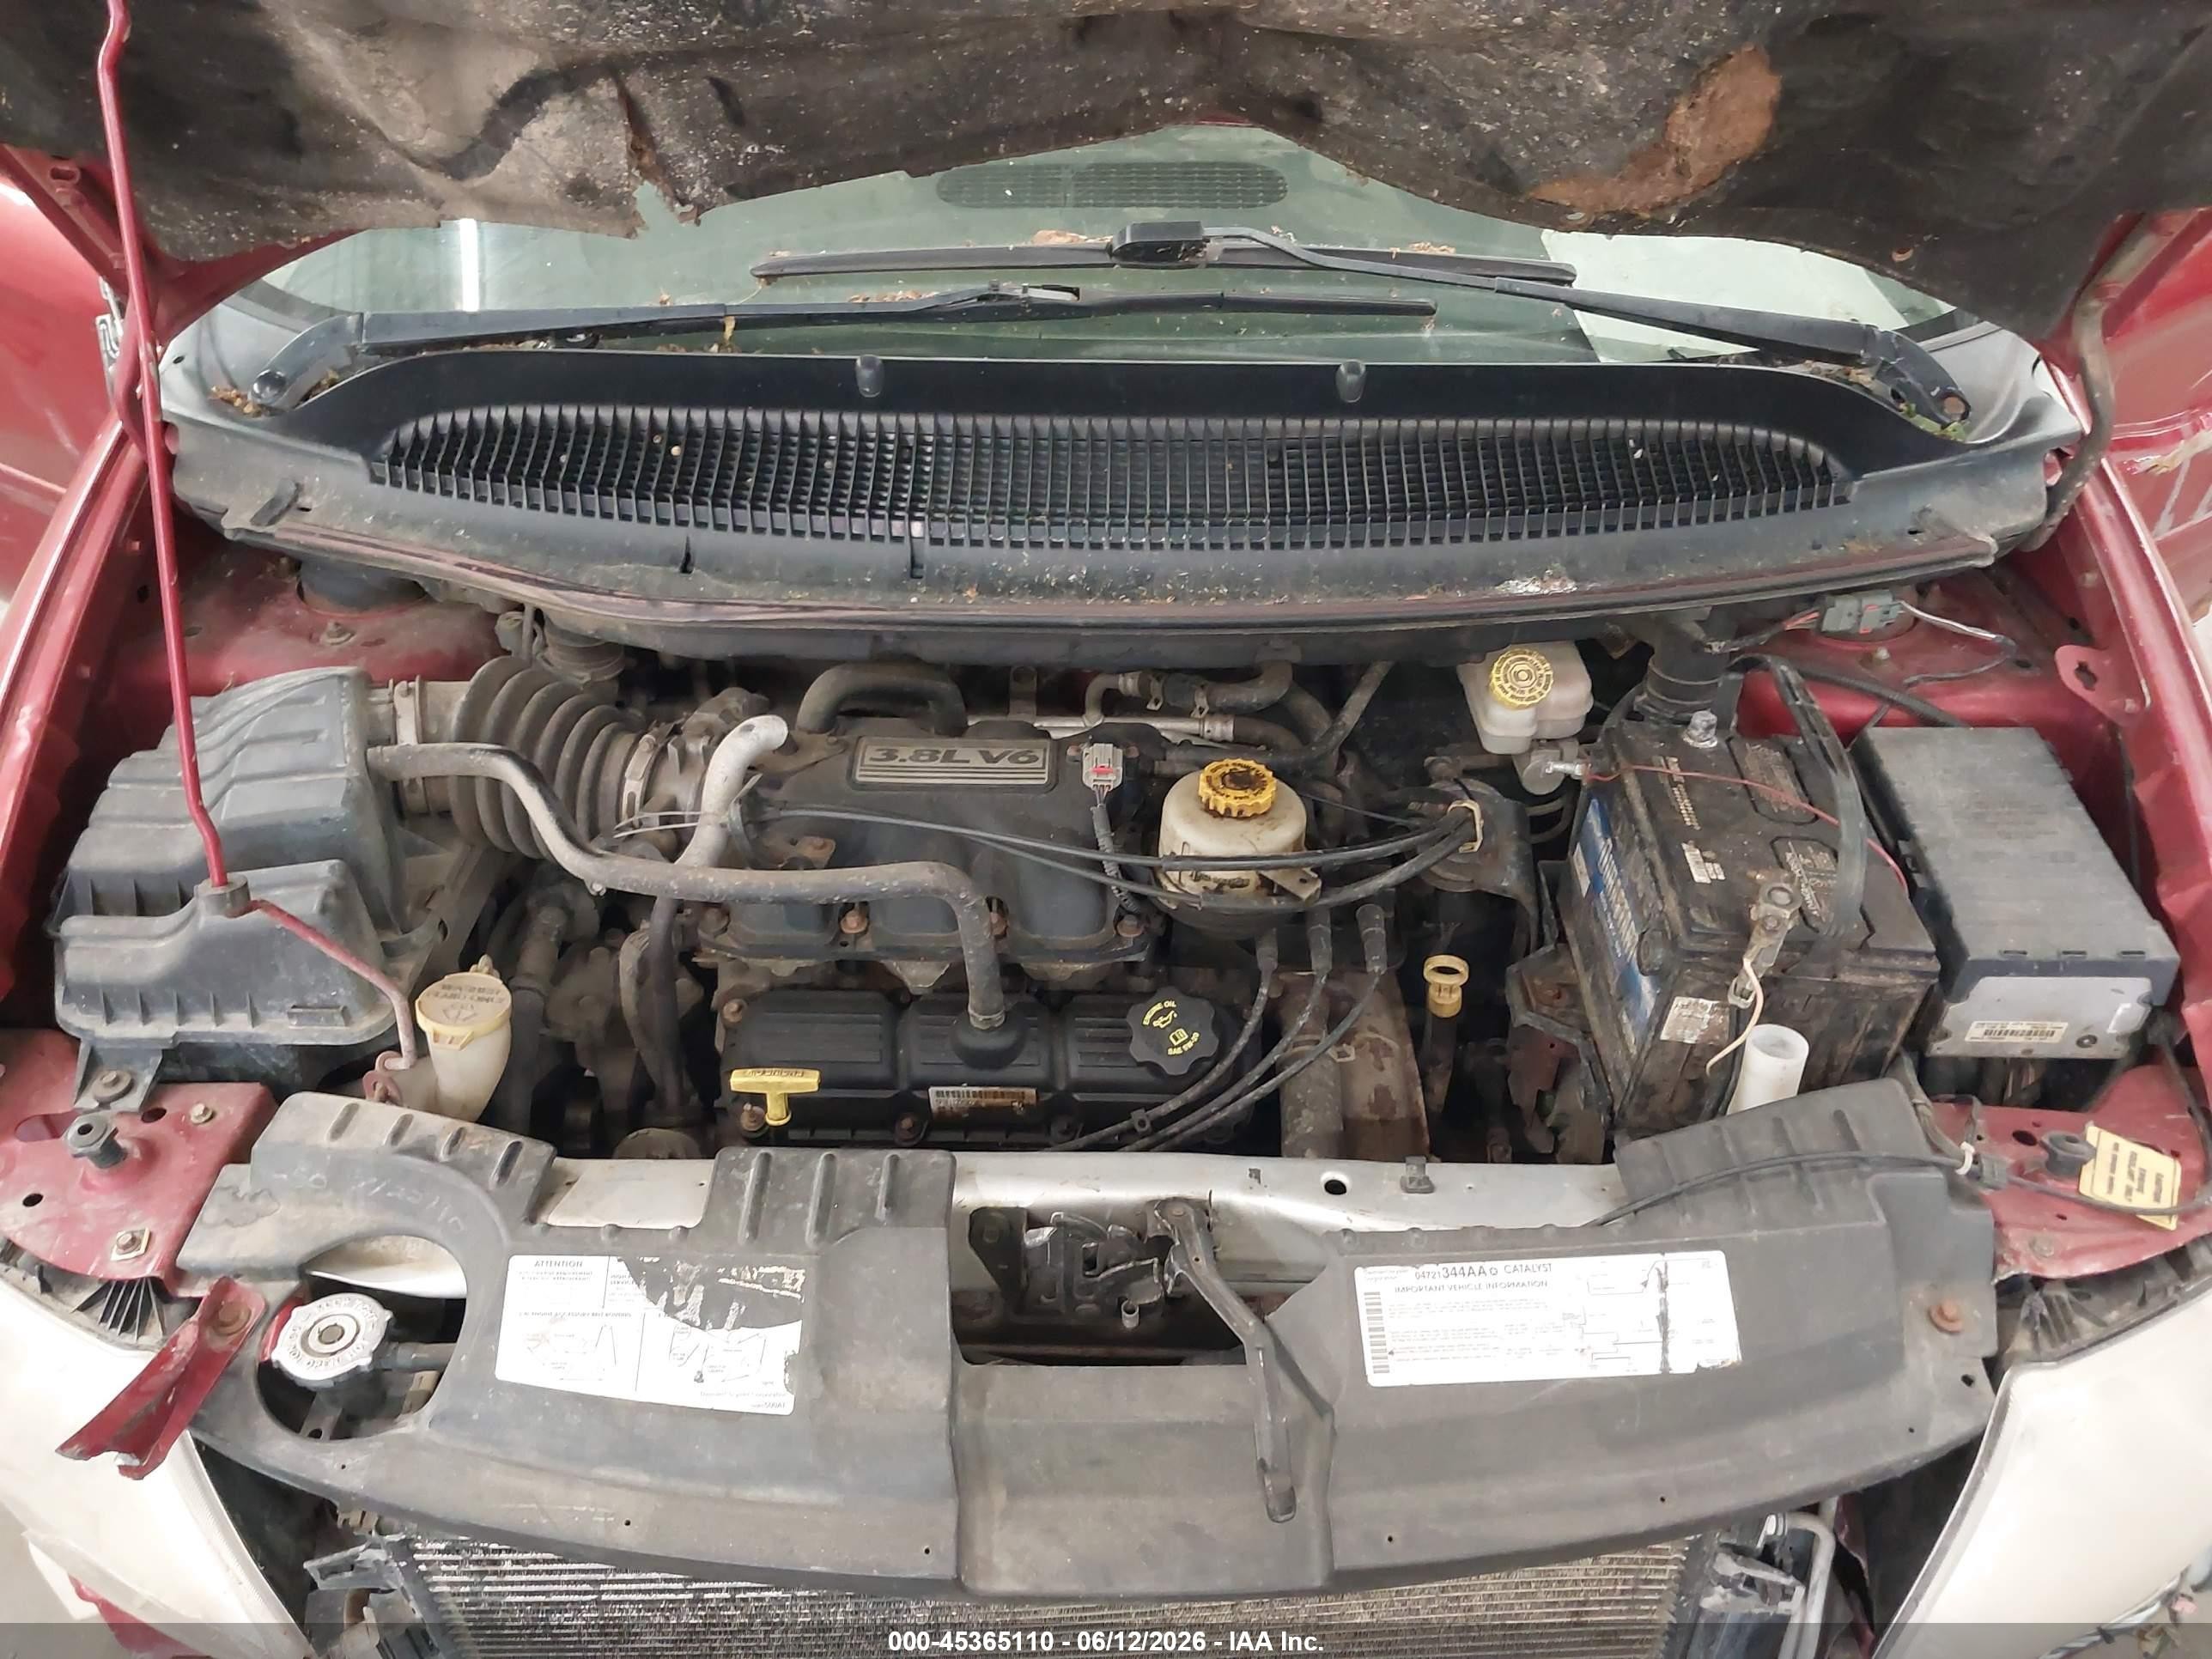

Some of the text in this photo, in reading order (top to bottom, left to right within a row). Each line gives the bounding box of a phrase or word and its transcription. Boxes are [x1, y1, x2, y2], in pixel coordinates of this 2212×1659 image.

[869, 749, 1040, 764] 3.8L V6
[1504, 1263, 1553, 1273] CATALYST
[1395, 1284, 1444, 1292] IMPORTANT
[1486, 1280, 1548, 1289] INFORMATION
